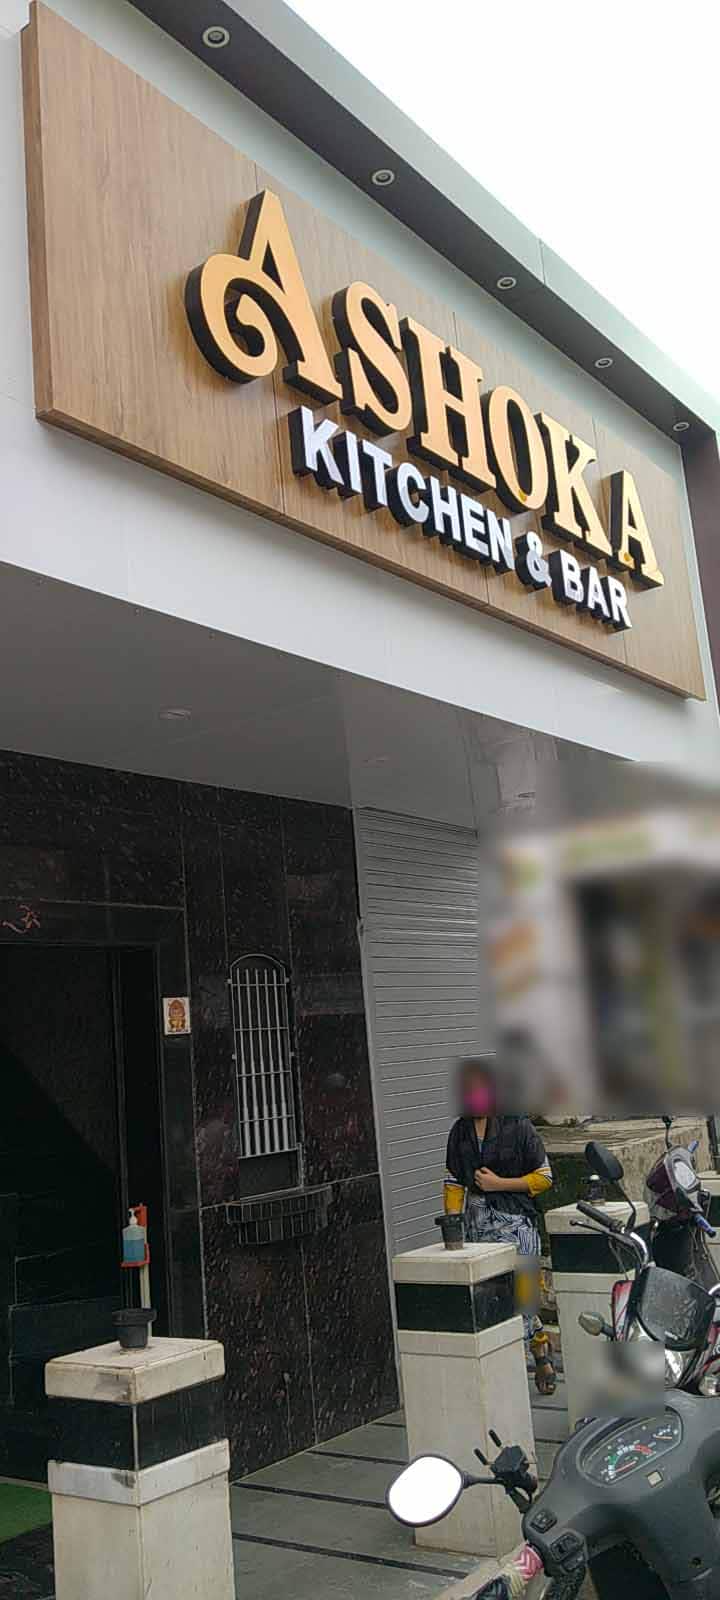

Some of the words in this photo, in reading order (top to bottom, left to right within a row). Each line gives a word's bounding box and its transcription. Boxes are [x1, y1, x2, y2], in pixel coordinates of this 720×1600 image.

[188, 189, 664, 588] ASHOKA
[296, 405, 515, 571] KITCHEN
[522, 531, 552, 587] &
[558, 549, 632, 629] BAR
